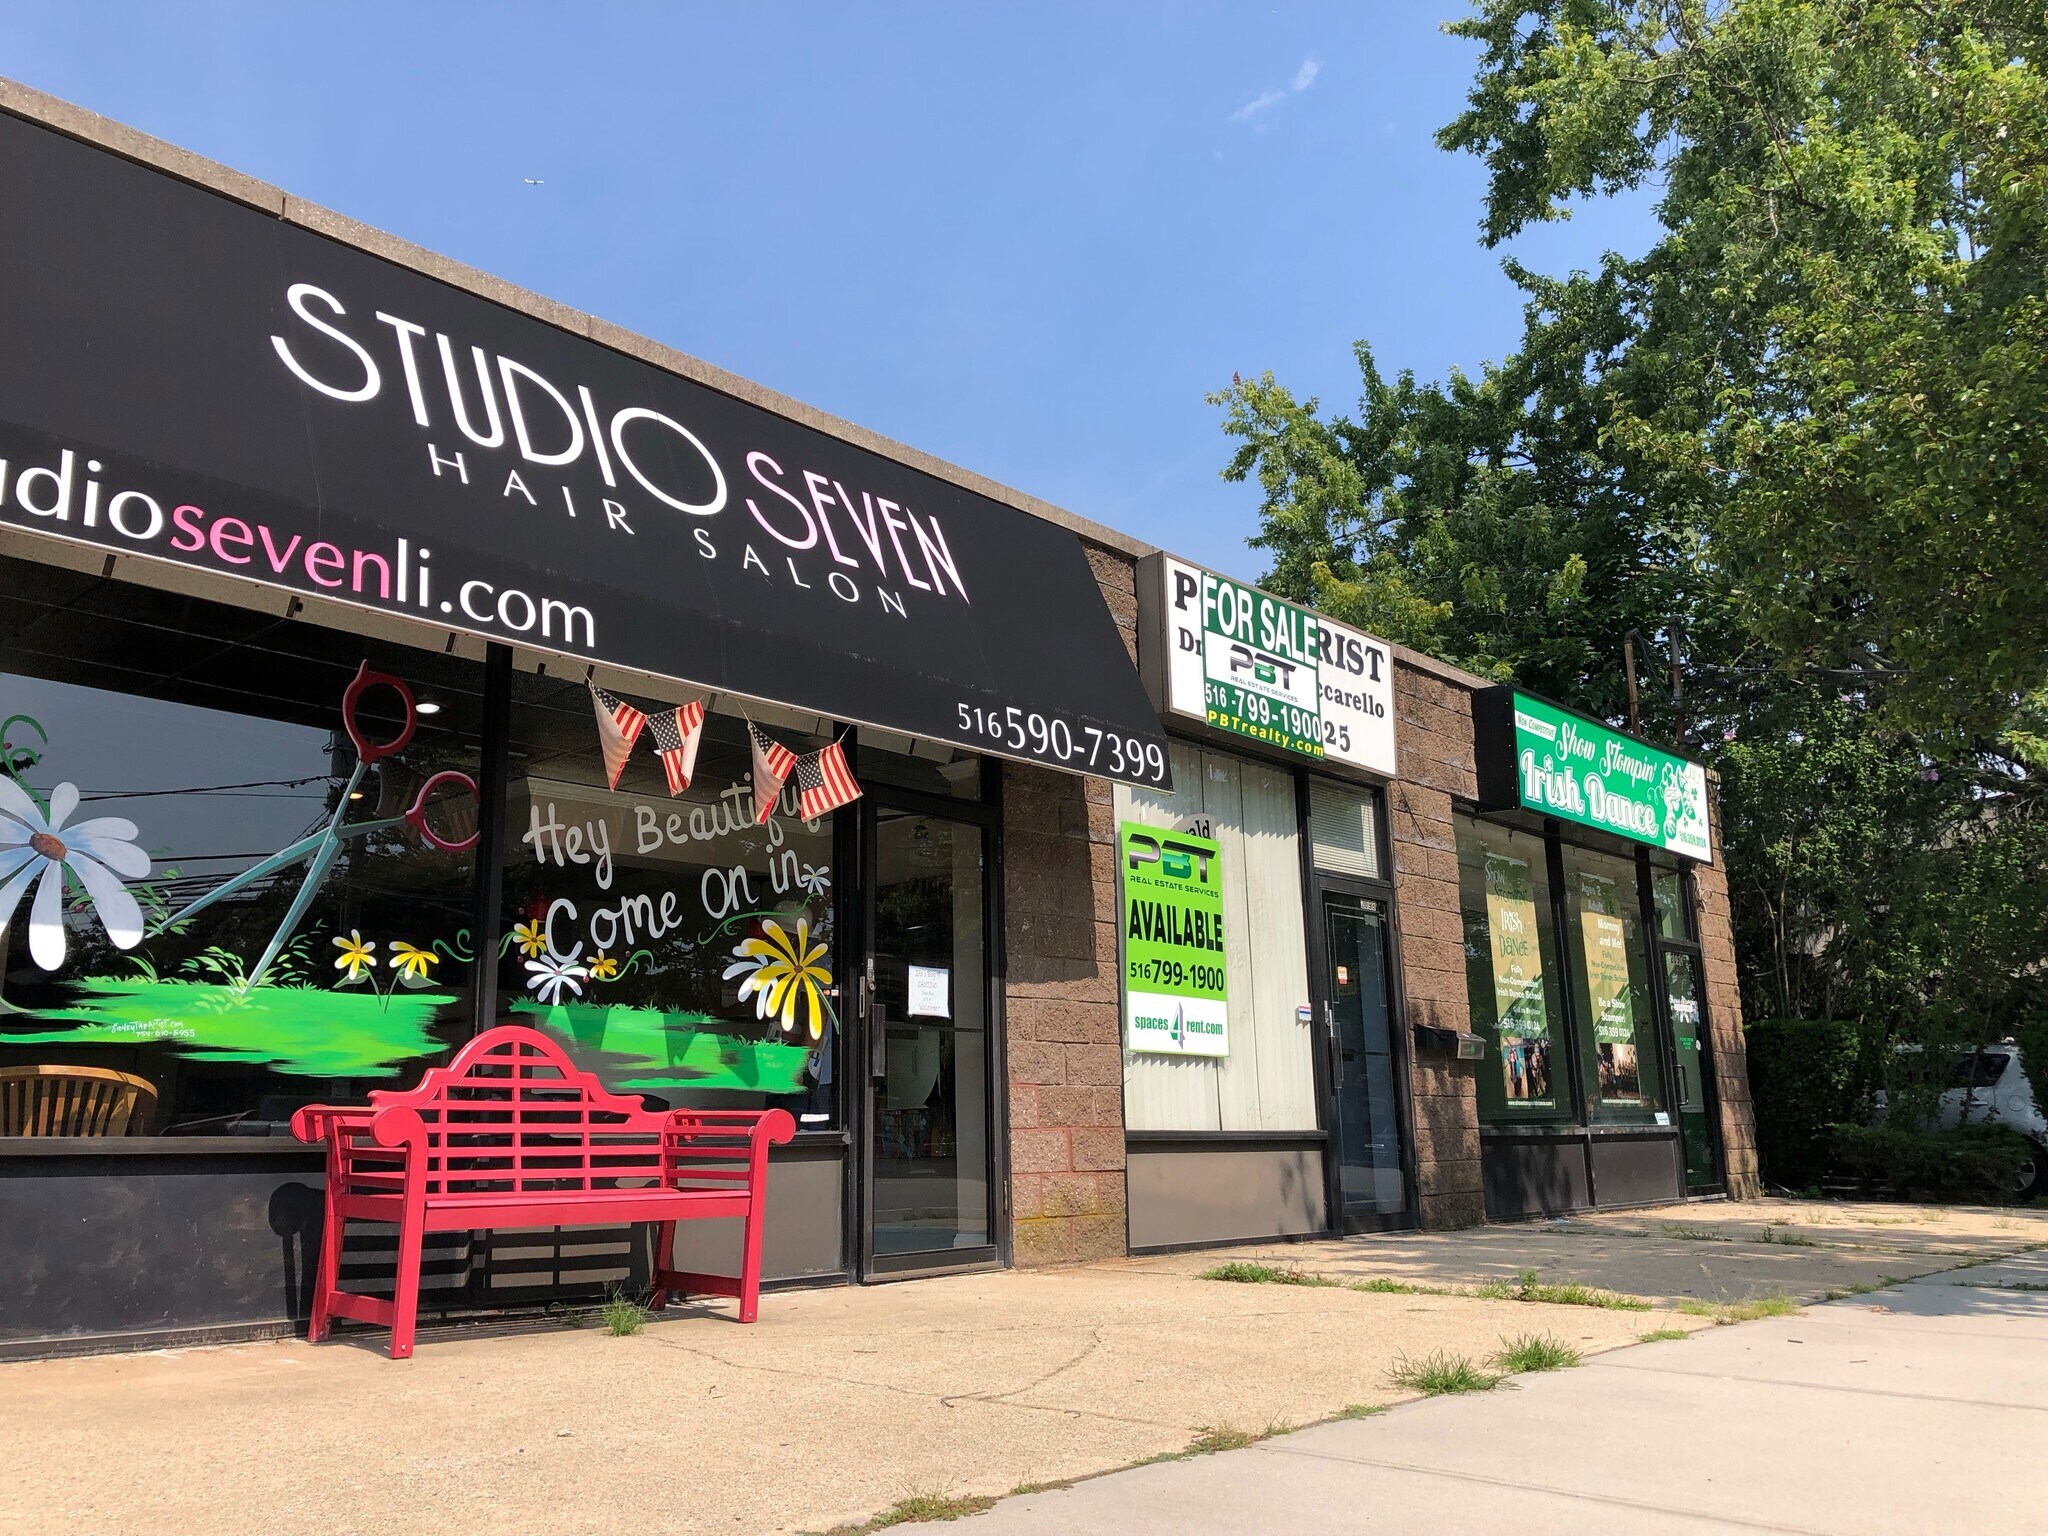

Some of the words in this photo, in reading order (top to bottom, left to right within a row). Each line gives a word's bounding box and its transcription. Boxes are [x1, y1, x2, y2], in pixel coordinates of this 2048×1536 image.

[270, 283, 727, 516] STUDIO
[745, 450, 970, 605] SEVEN
[0, 448, 596, 648] diosevenli.com
[427, 443, 635, 535] HAIR
[693, 528, 908, 618] SALON
[1203, 575, 1254, 643] FOR
[1260, 598, 1318, 667] SALE
[1230, 643, 1297, 690] PBT
[1230, 675, 1247, 686] REAL
[1247, 679, 1270, 695] ESTATE
[1270, 686, 1298, 703] SERVICES
[957, 702, 1002, 739] 516
[1004, 706, 1166, 782] 590-7399
[1207, 709, 1324, 758] PBTrealty.com
[1555, 722, 1596, 761] Show
[1599, 739, 1657, 788] Stompin'
[1520, 748, 1585, 816] Irish
[1583, 771, 1659, 838] Dance
[522, 802, 613, 890] Hey
[634, 772, 821, 854] Beautifu
[1128, 833, 1217, 884] PBT
[545, 891, 683, 963] Come
[701, 865, 759, 919] On
[765, 844, 809, 894] in
[1130, 875, 1152, 885] REAL
[1154, 879, 1183, 891] ESTATE
[1184, 884, 1219, 898] SERVICES
[1128, 898, 1223, 953] AVAILABLE
[1599, 935, 1611, 947] and
[1130, 961, 1151, 980] 516
[1151, 959, 1225, 992] 799-1900
[1597, 996, 1606, 1007] Be
